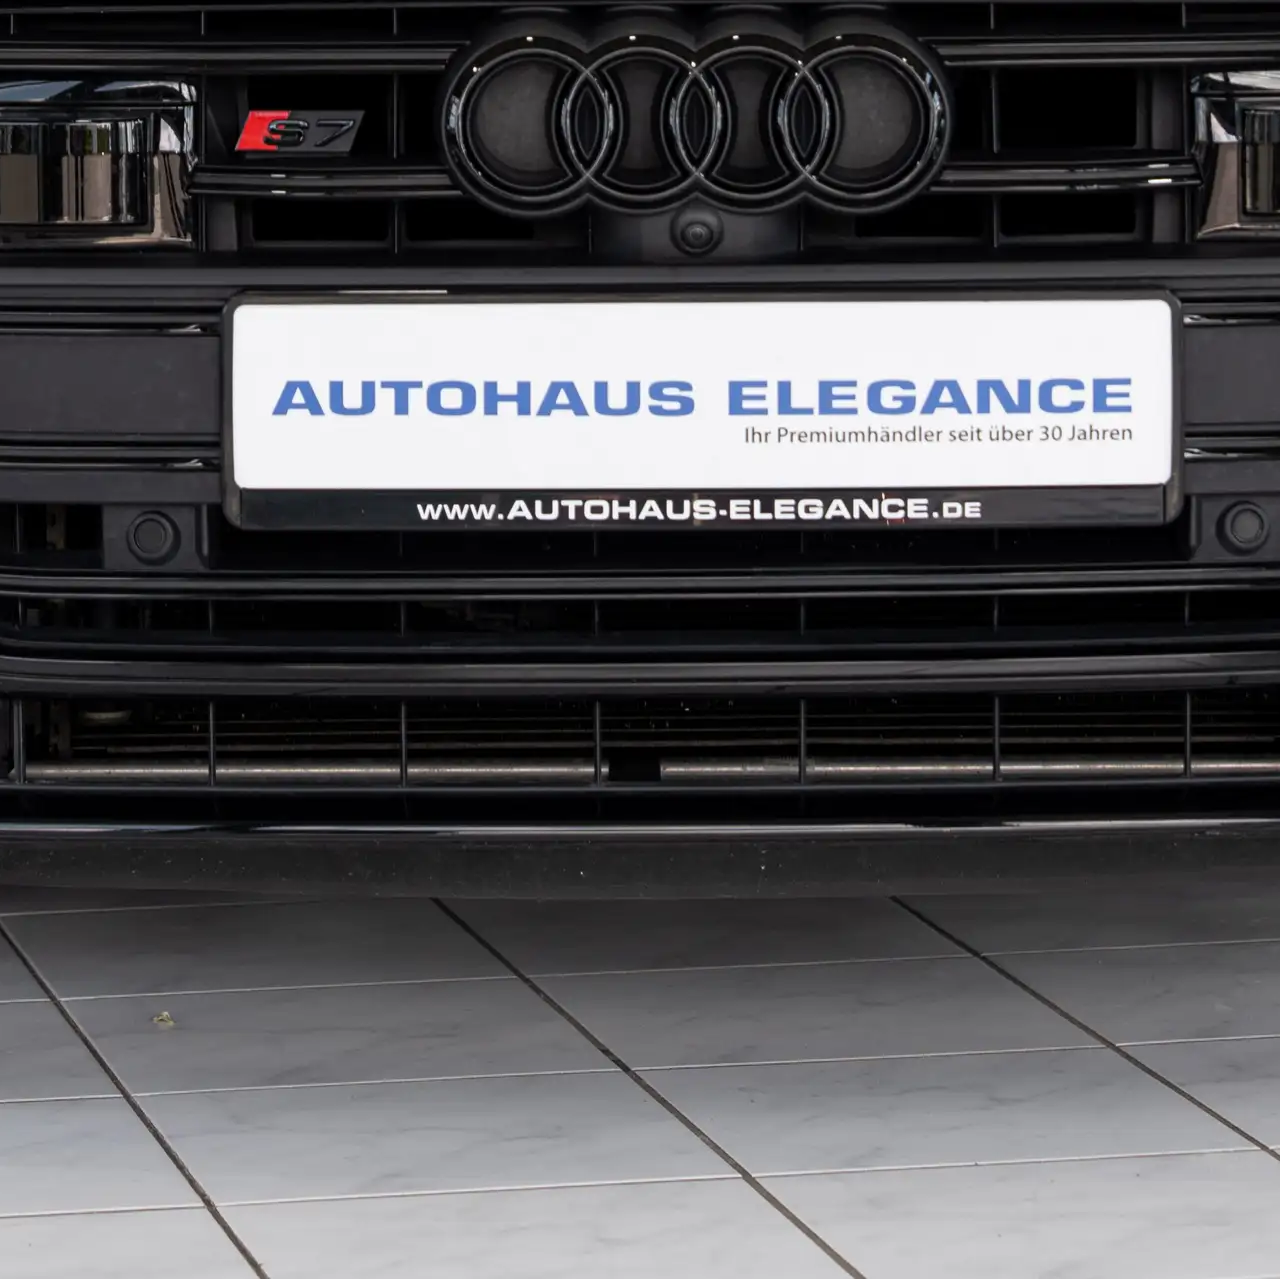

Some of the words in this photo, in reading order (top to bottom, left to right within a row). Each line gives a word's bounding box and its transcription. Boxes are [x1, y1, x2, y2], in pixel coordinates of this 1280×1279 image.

[263, 119, 355, 148] S7
[271, 380, 695, 417] AUTOHAUS
[728, 377, 1132, 416] ELEGANCE
[744, 425, 771, 443] Ihr
[777, 425, 943, 443] Premiumhändler
[949, 425, 983, 442] seit
[989, 424, 1034, 442] über
[1039, 424, 1063, 442] 30
[1068, 423, 1133, 442] Jahren
